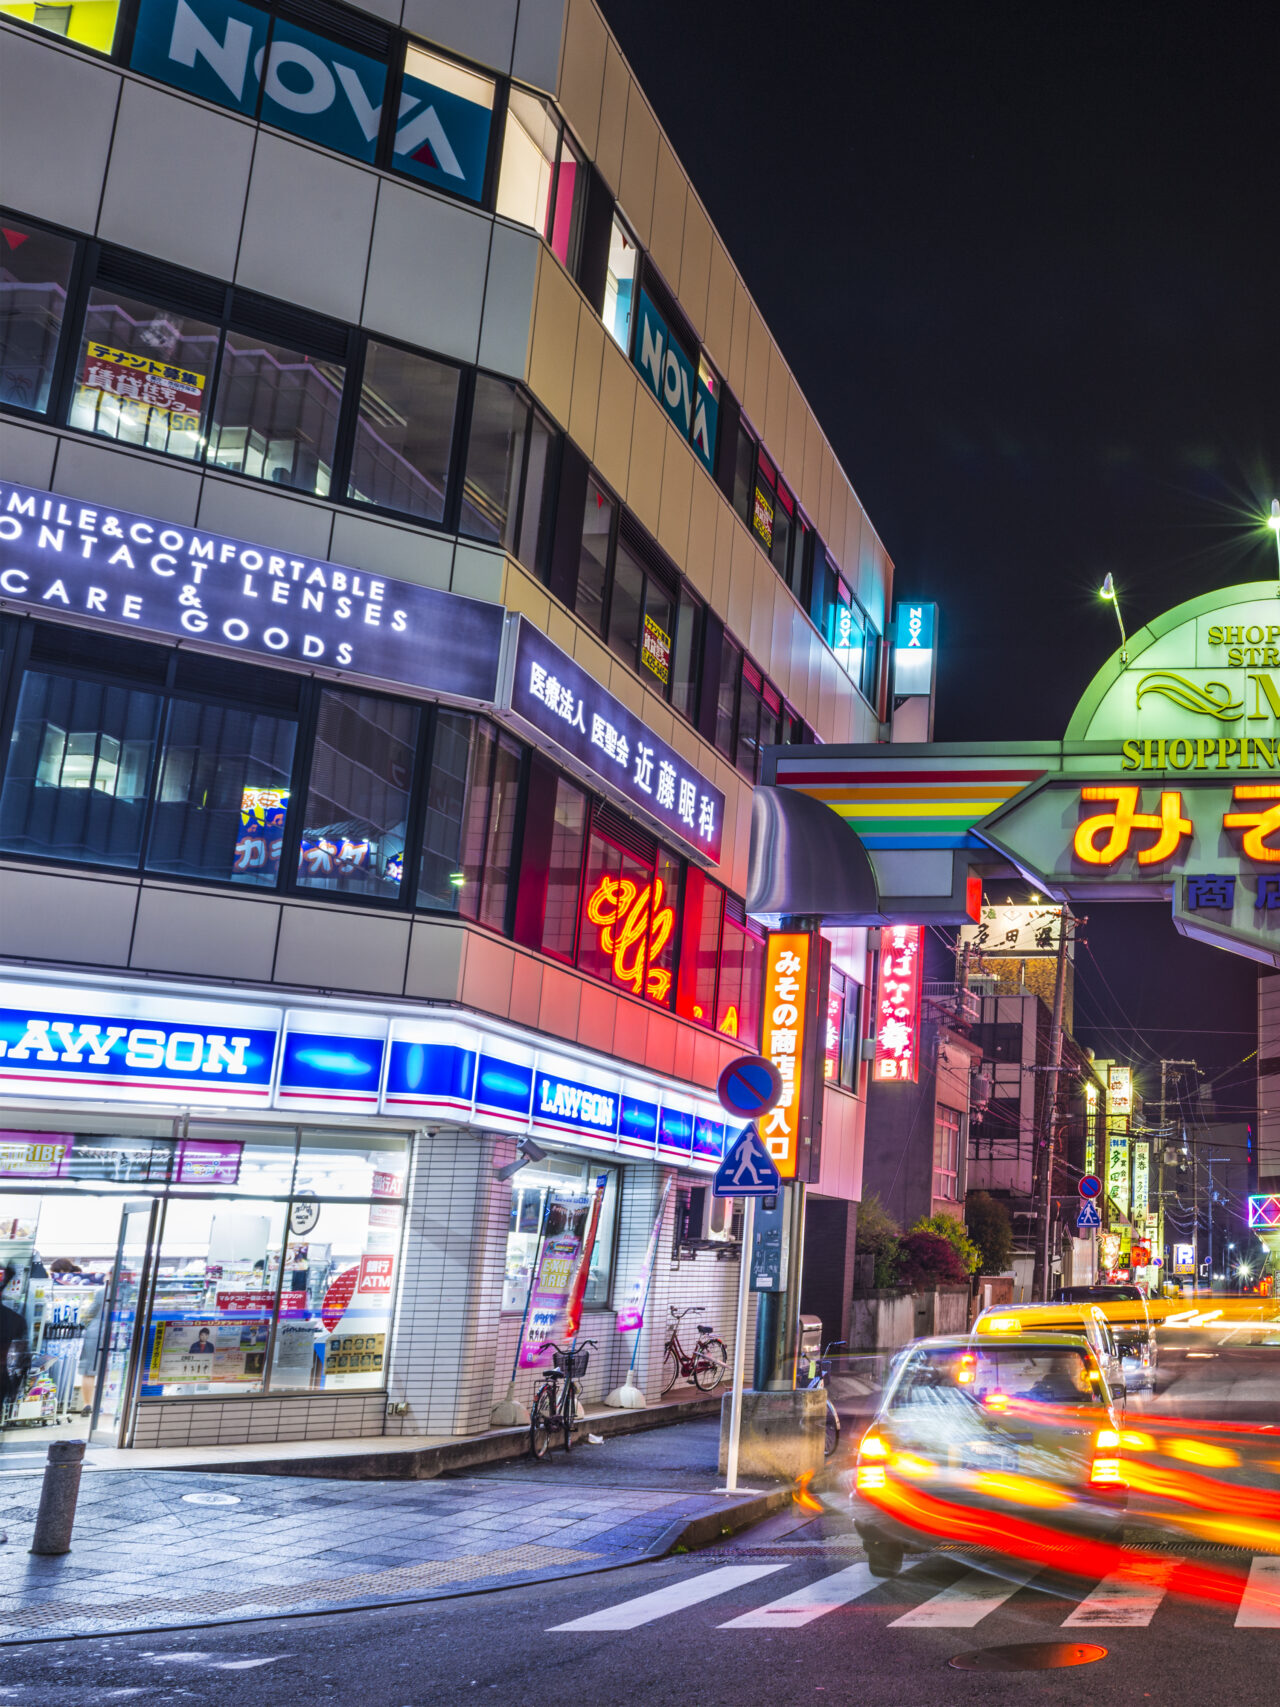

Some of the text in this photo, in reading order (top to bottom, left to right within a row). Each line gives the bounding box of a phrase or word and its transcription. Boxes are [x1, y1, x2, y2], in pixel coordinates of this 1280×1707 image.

[169, 0, 466, 181] NOVA
[93, 345, 198, 387] テナント募集
[641, 312, 710, 461] NOVA
[0, 490, 386, 601] MILE&COMFORTABLE
[0, 569, 353, 665] CARE GOODS
[178, 584, 202, 609] &
[243, 573, 408, 632] LENSES
[908, 607, 922, 647] NOVA
[529, 661, 716, 843] 医療法人 医聖会 近藤眼科
[0, 1020, 250, 1075] AWSON
[880, 1059, 909, 1078] B1
[540, 1079, 614, 1127] LAWSON
[361, 1275, 391, 1287] ATM
[366, 1261, 390, 1273] 銀行
[541, 1274, 569, 1288] TRIB
[542, 1259, 572, 1274] EXIL
